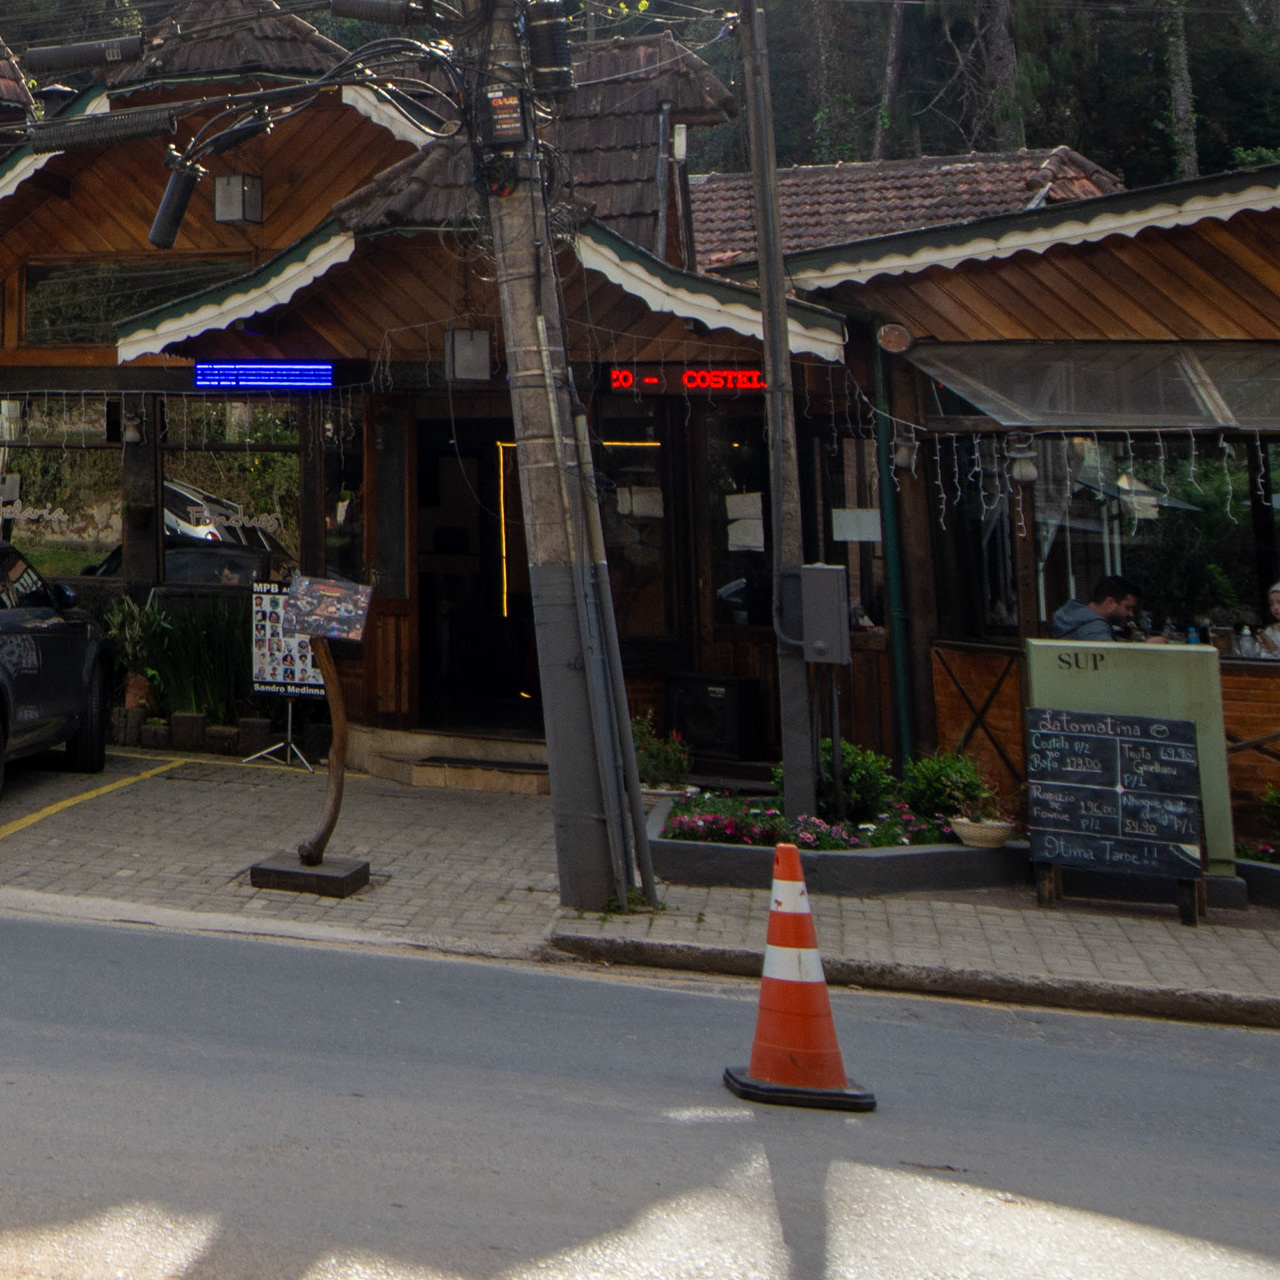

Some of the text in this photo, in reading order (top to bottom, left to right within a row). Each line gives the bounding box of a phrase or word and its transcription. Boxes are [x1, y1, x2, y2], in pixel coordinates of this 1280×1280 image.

[186, 504, 280, 533] Fondues
[253, 582, 280, 594] MPB
[254, 682, 285, 694] Sandro
